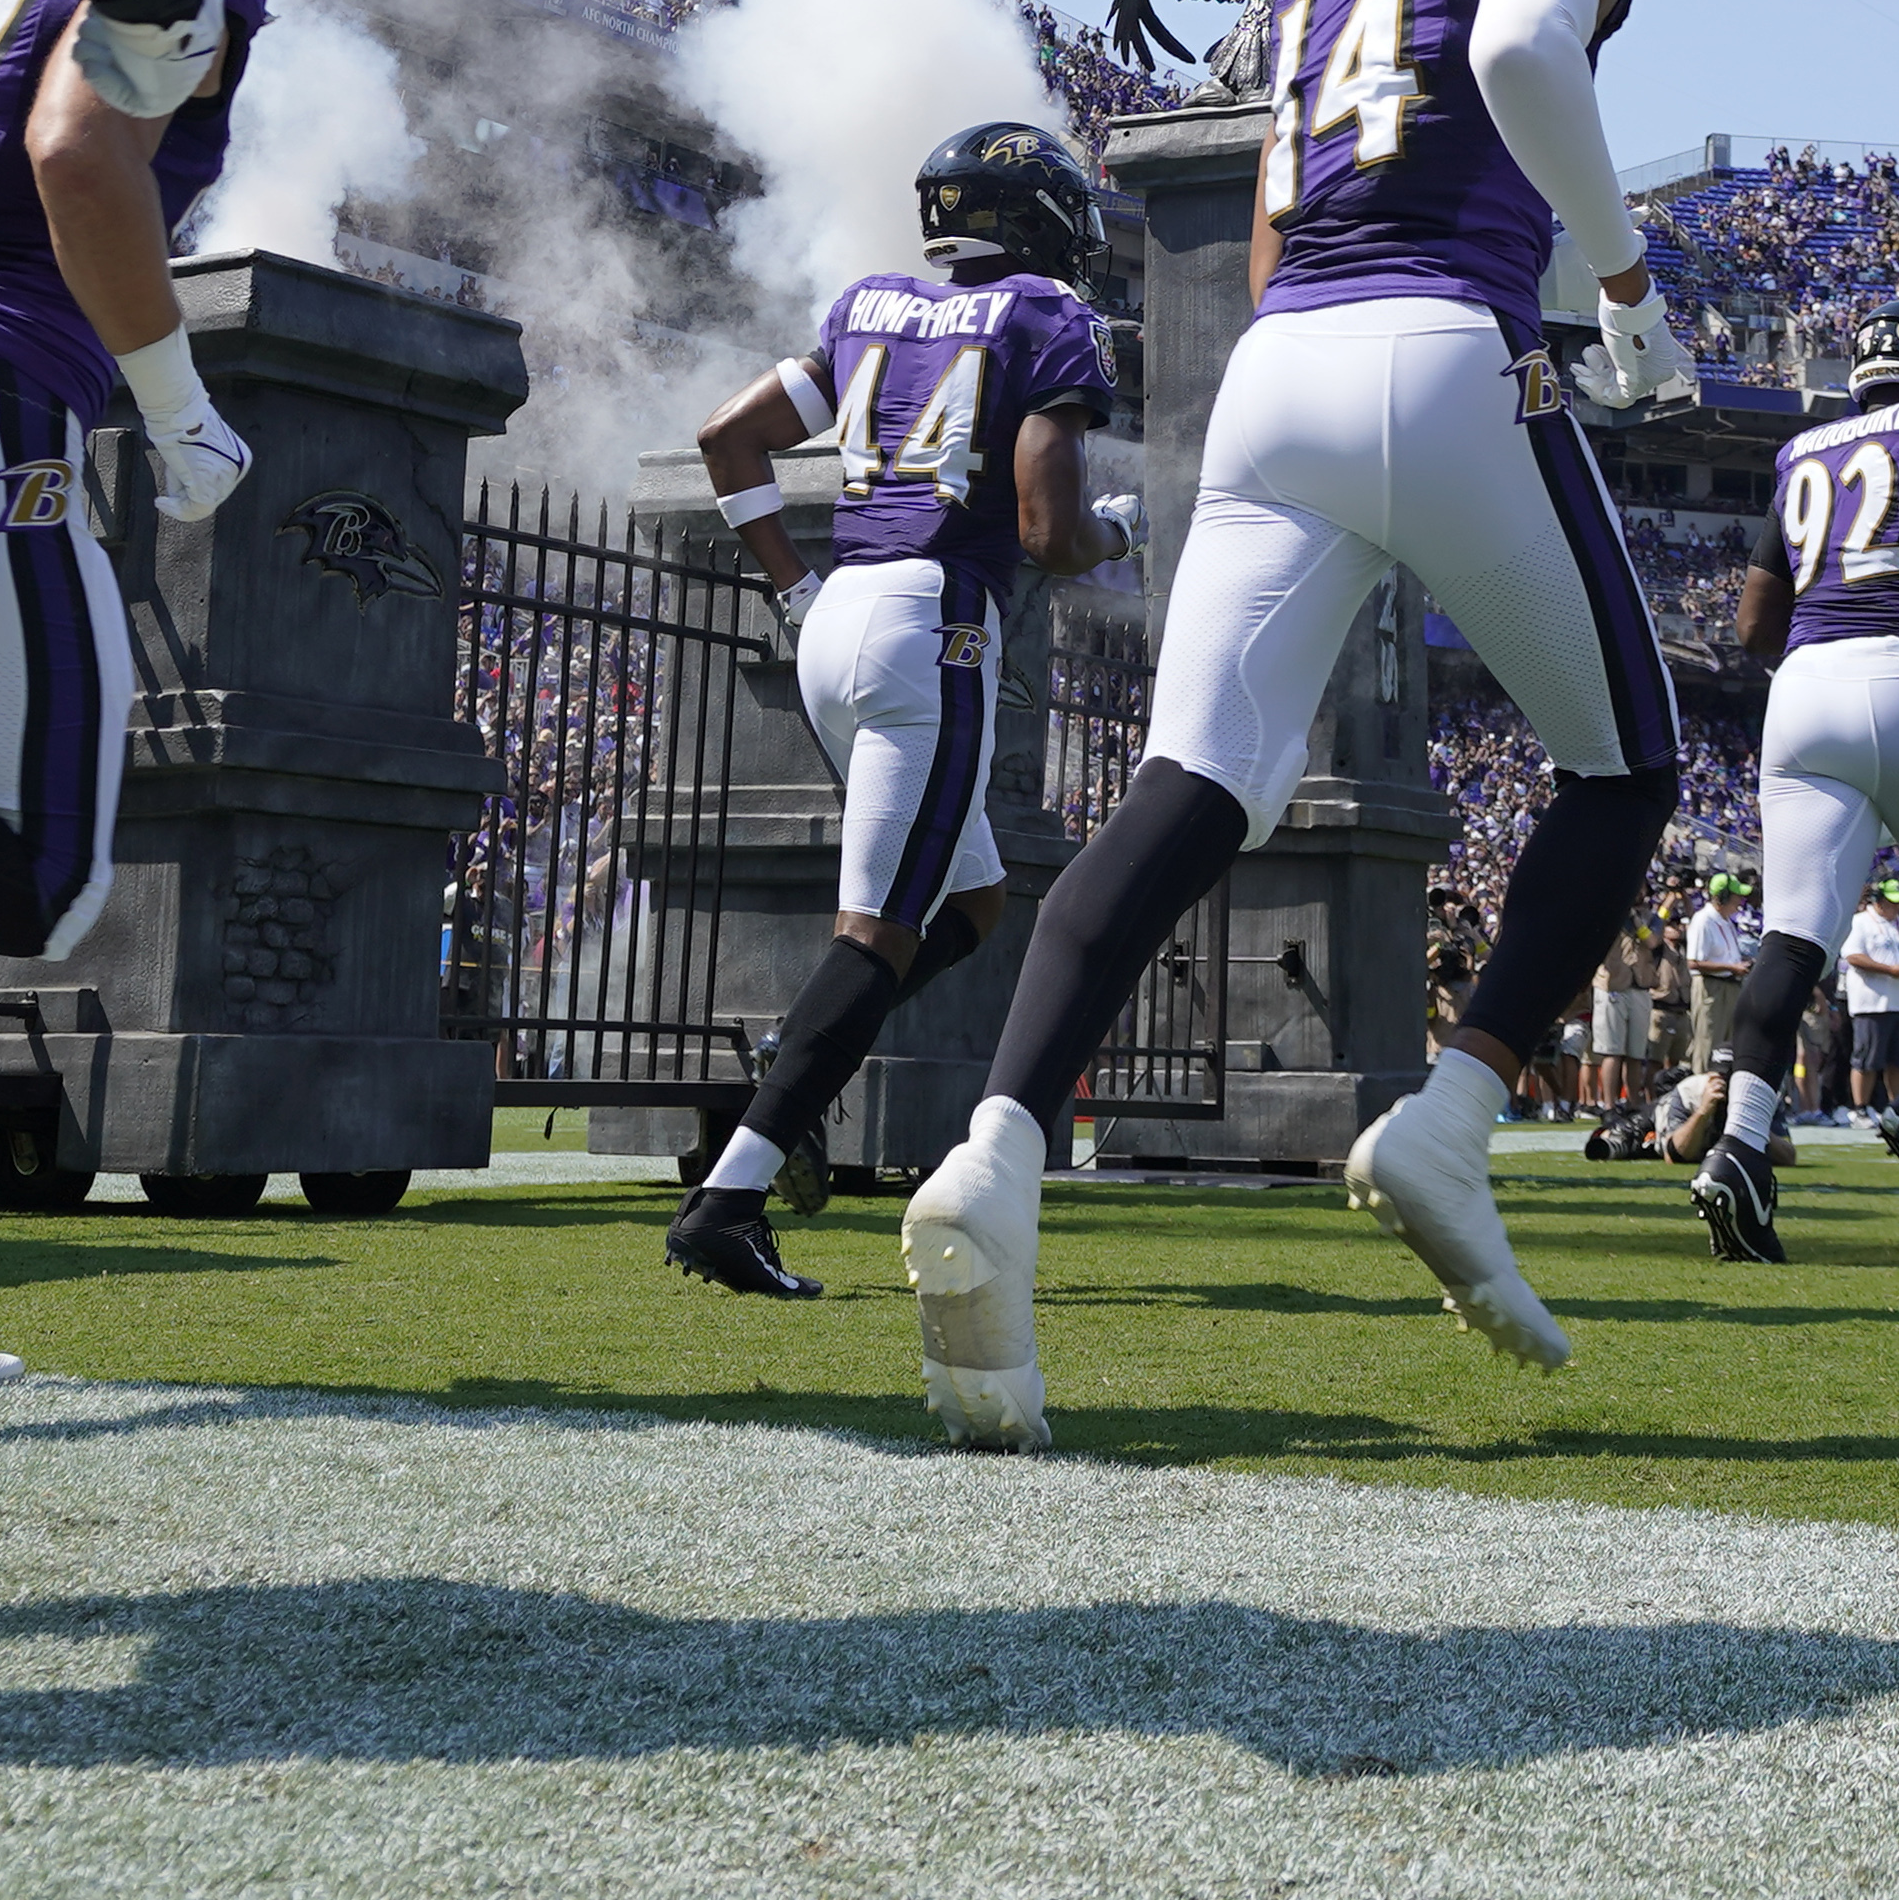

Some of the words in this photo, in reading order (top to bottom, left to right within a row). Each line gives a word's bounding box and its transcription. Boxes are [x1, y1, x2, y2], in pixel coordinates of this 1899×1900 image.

[581, 6, 601, 24] AFC
[602, 12, 635, 39] NORTH
[636, 26, 681, 55] CHAMPIO
[838, 343, 990, 510] 44
